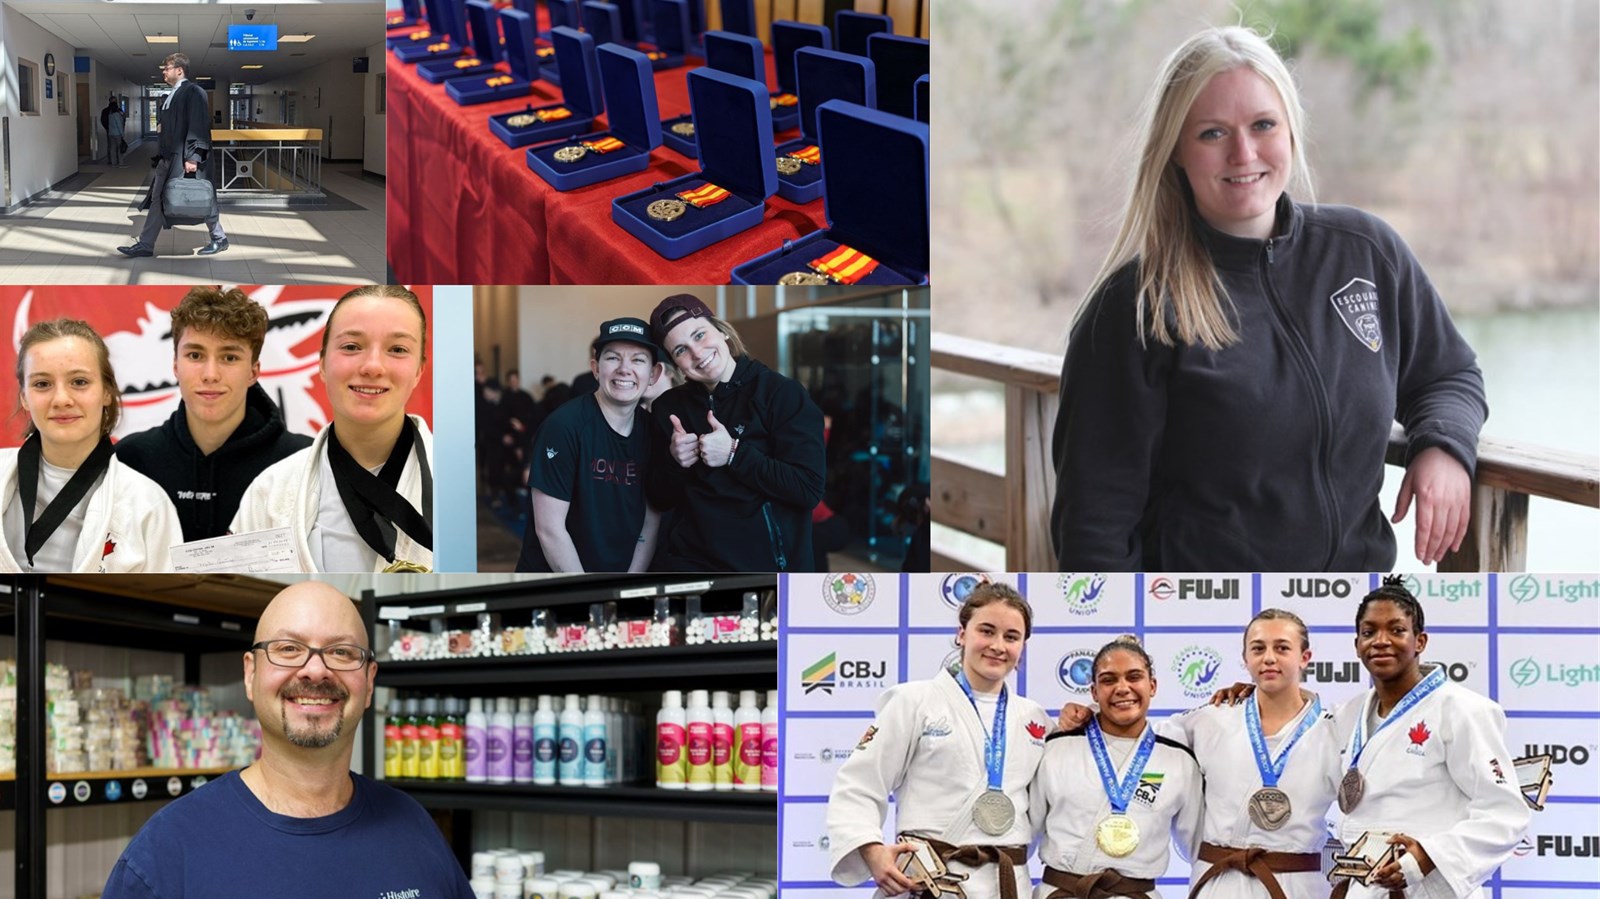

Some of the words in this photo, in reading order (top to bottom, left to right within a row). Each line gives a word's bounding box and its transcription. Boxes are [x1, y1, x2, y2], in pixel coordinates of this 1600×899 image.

[610, 324, 643, 335] CCM
[1179, 578, 1240, 600] FUJI
[1281, 578, 1351, 599] JUDO
[1427, 579, 1482, 602] Light
[1546, 580, 1600, 603] Light
[1069, 607, 1098, 616] UNION
[839, 660, 886, 679] CBJ
[1302, 661, 1360, 683] FUJI
[1546, 664, 1600, 687] Light
[1184, 690, 1212, 699] UNION
[1134, 787, 1156, 804] CBJ
[1537, 835, 1600, 857] FUJI
